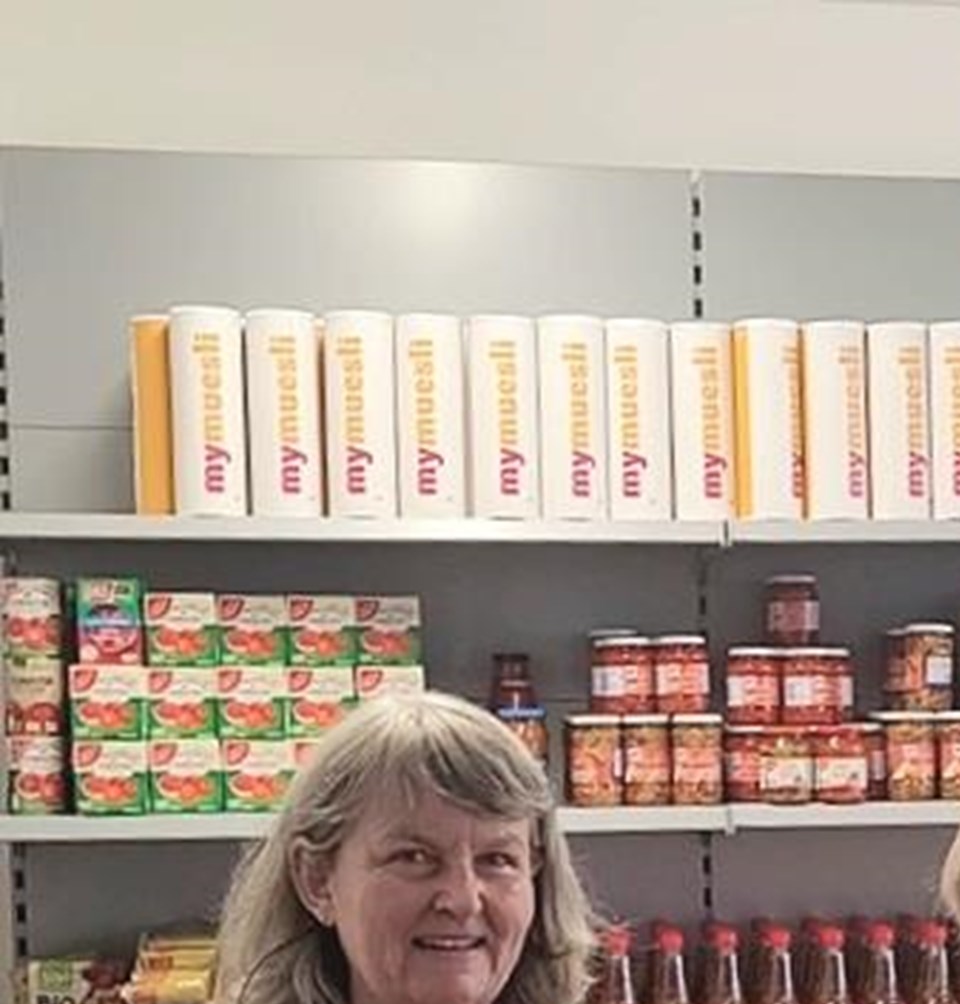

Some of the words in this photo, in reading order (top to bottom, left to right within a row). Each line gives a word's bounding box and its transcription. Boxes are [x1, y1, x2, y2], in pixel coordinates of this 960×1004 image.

[193, 333, 231, 494] mymuesli
[269, 336, 308, 495] mymuesli
[336, 336, 374, 495] mymuesli
[409, 339, 445, 496] mymuesli
[489, 340, 526, 496] mymuesli
[562, 342, 597, 498] mymuesli
[613, 344, 648, 498] mymuesli
[692, 344, 729, 499] mymuesli
[838, 346, 866, 498] mymuesli
[898, 346, 929, 498] mymuesli
